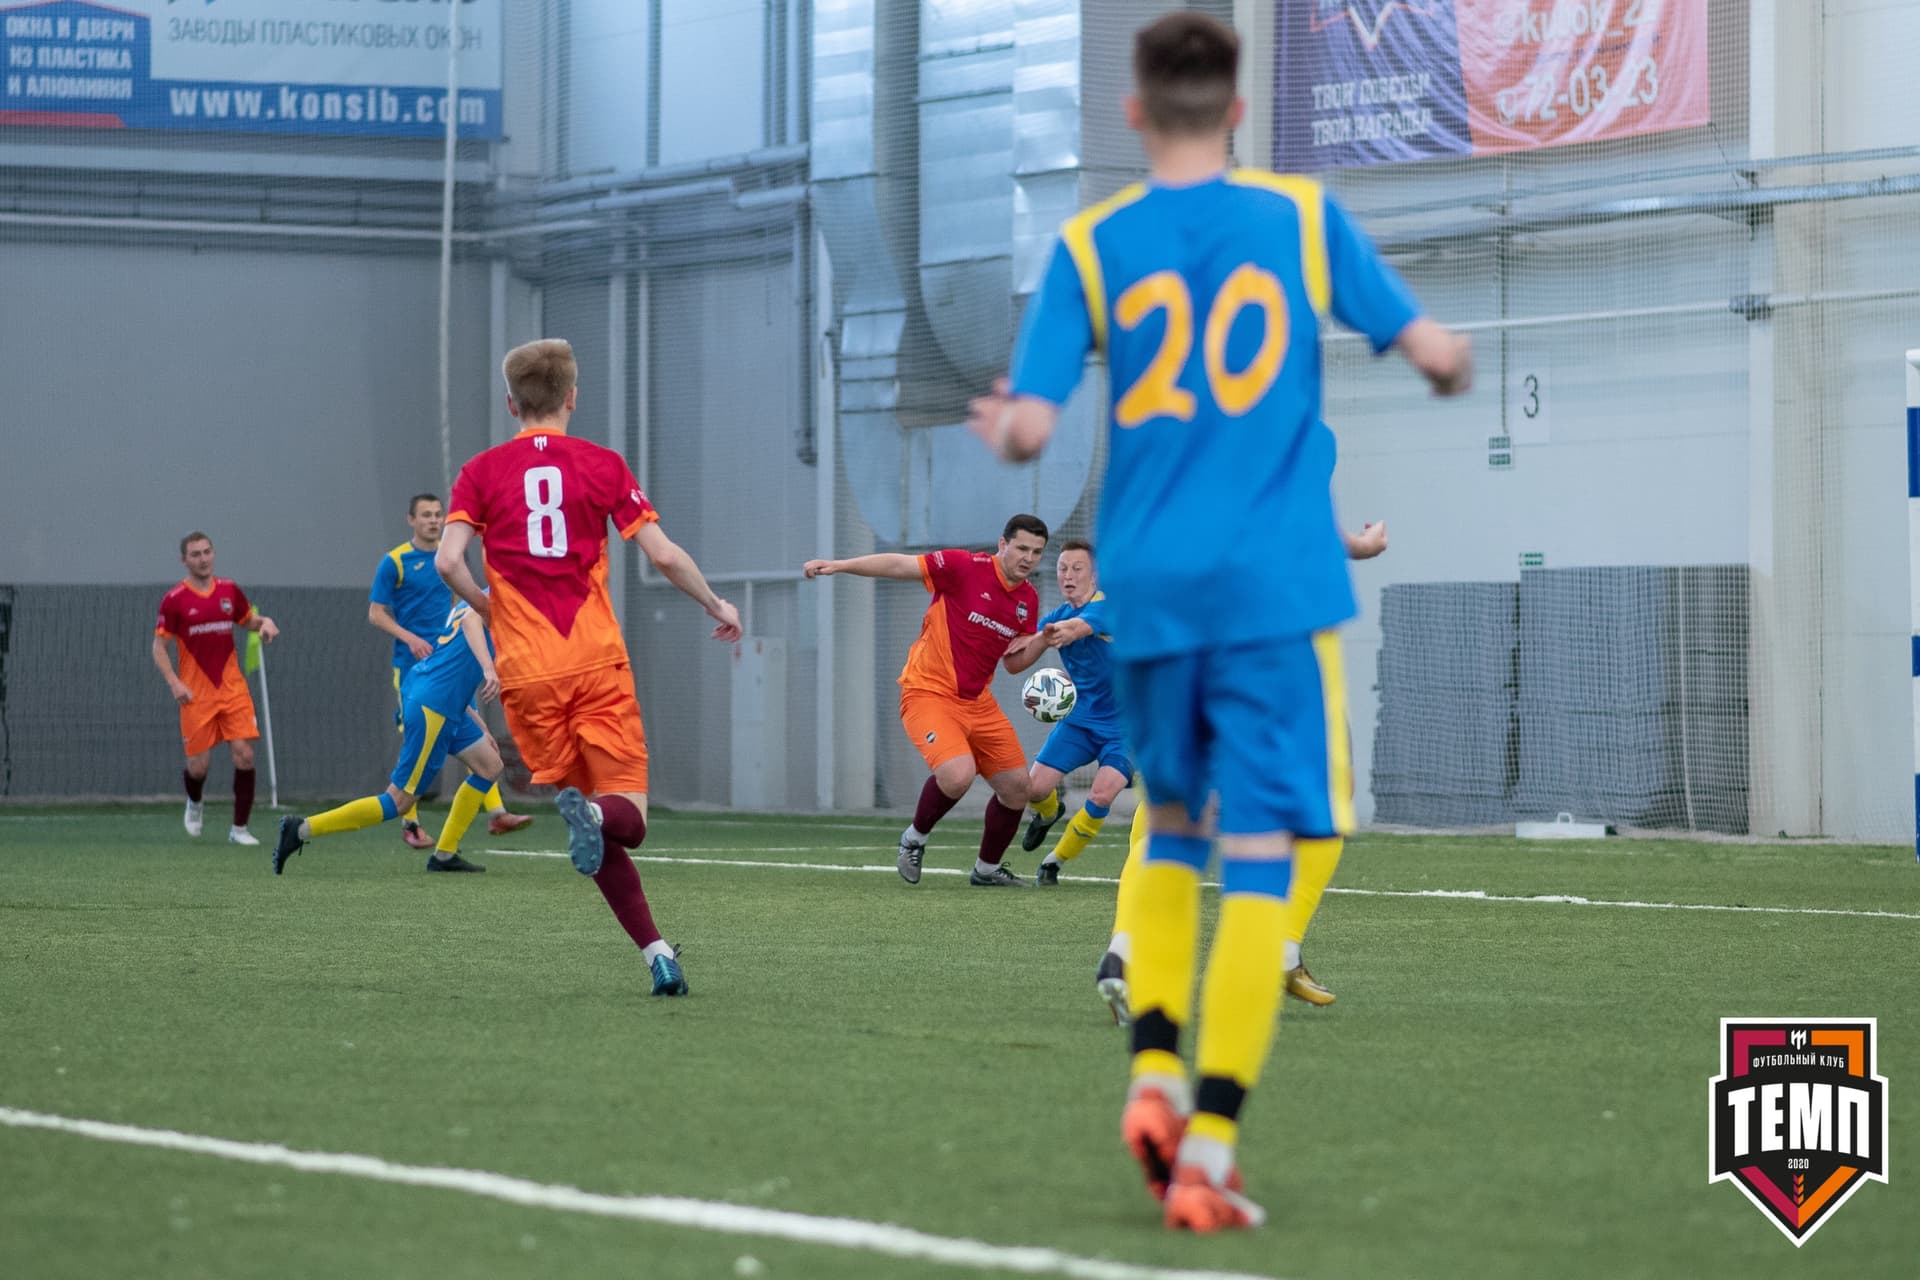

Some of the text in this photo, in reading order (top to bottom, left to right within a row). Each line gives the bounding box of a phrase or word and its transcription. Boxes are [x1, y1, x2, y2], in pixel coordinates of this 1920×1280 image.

[6, 16, 135, 41] ОКНА И ДВЕРИ
[168, 17, 256, 45] ЗАВОДЫ
[262, 20, 418, 48] ПЛАСТИКОВЫХ
[10, 45, 132, 69] ИЗ ПЛАСТИКА
[7, 74, 132, 99] И АЛЮМИНИЯ
[170, 86, 486, 125] www.konsib.com
[1115, 262, 1289, 428] 20
[1523, 374, 1539, 418] 3
[524, 466, 568, 557] 8
